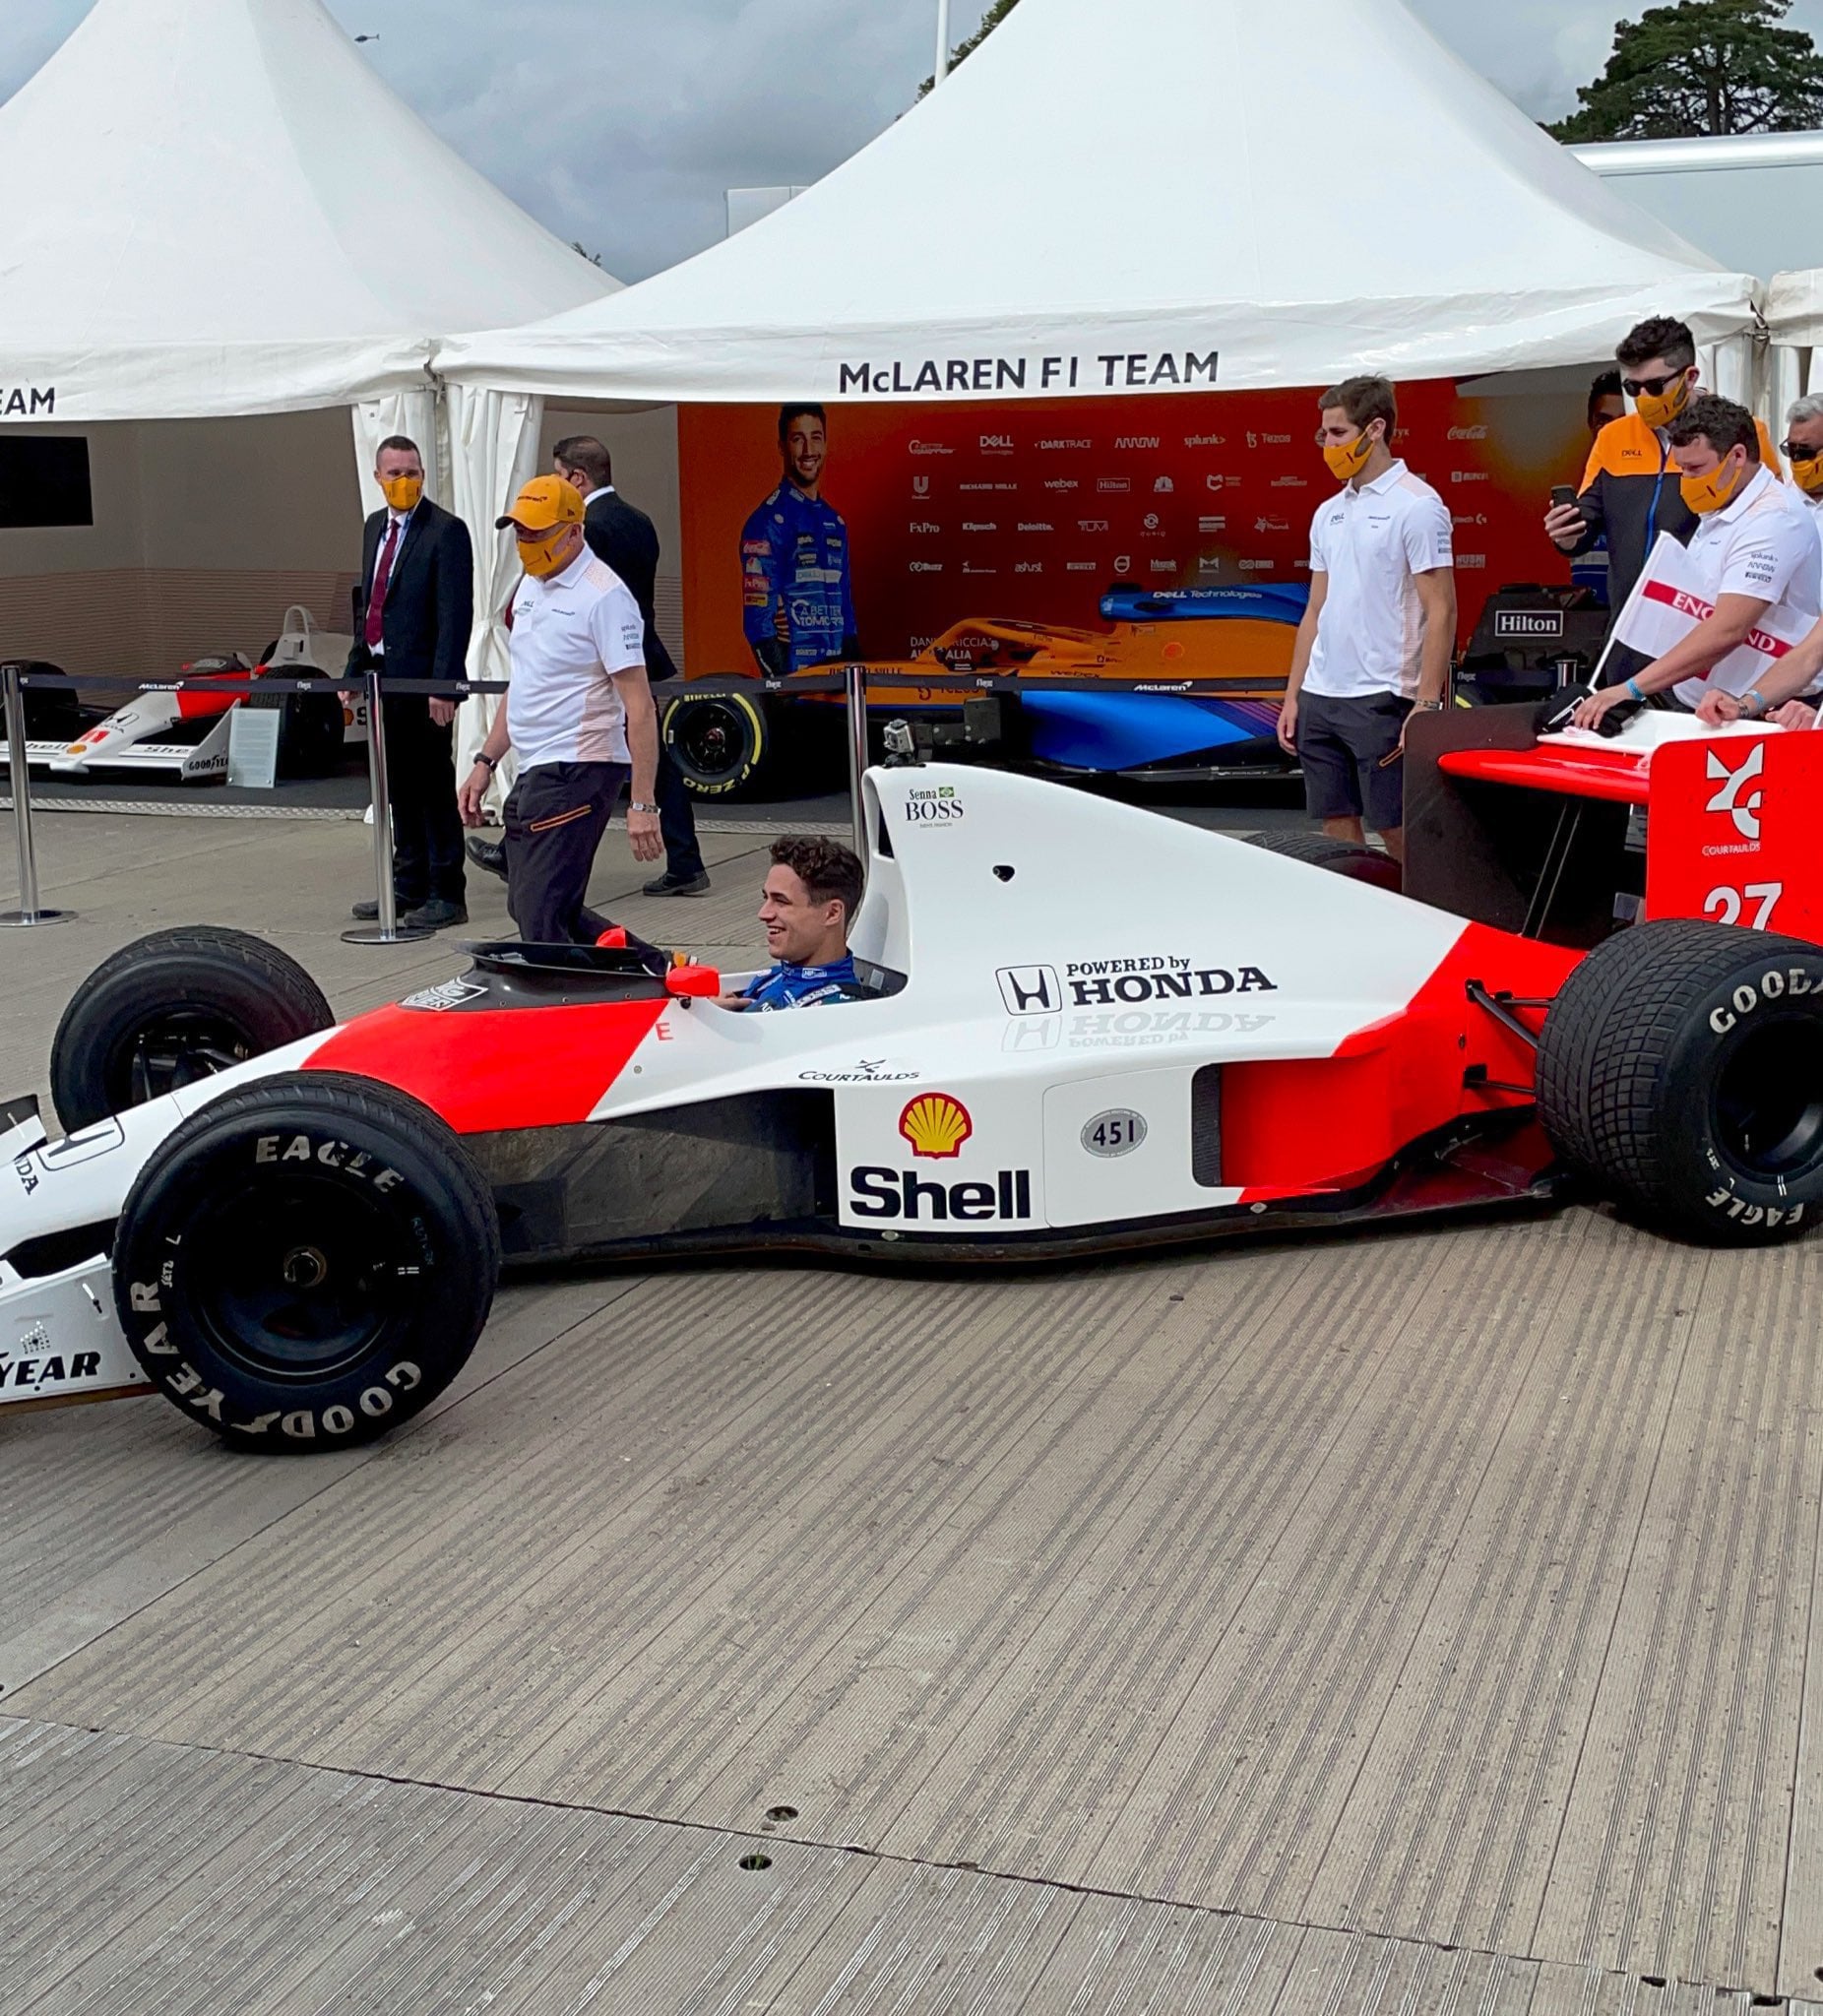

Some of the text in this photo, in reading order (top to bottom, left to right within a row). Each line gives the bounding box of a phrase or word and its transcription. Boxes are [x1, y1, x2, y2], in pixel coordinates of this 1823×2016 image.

[839, 358, 1026, 394] McLAREN
[1098, 350, 1220, 387] TEAM
[0, 386, 55, 415] AM
[979, 434, 1015, 448] DELL
[1040, 439, 1093, 450] DARKTRACE
[1044, 477, 1079, 489] webex
[1099, 479, 1128, 490] Hilton
[910, 522, 941, 534] FxPro
[1153, 591, 1187, 599] DELL
[1500, 614, 1557, 632] Hilton
[138, 681, 184, 691] McLaren
[975, 677, 994, 688] flex
[1133, 681, 1193, 692] McLaren
[682, 777, 736, 794] ZERO
[909, 788, 938, 800] Senna
[905, 799, 965, 822] BOSS
[1701, 842, 1762, 857] COURTAULDS
[1703, 881, 1784, 931] 27
[1066, 955, 1191, 977] POWERED by
[1068, 966, 1279, 1007] HONDA
[656, 1022, 674, 1041] E
[797, 1071, 920, 1083] COURTAULDS
[1092, 1119, 1134, 1147] 451
[255, 1135, 405, 1194] EAGLE
[849, 1166, 1032, 1222] Shell
[1705, 1186, 1805, 1228] EAGLE
[129, 1281, 423, 1439] GOODYEAR
